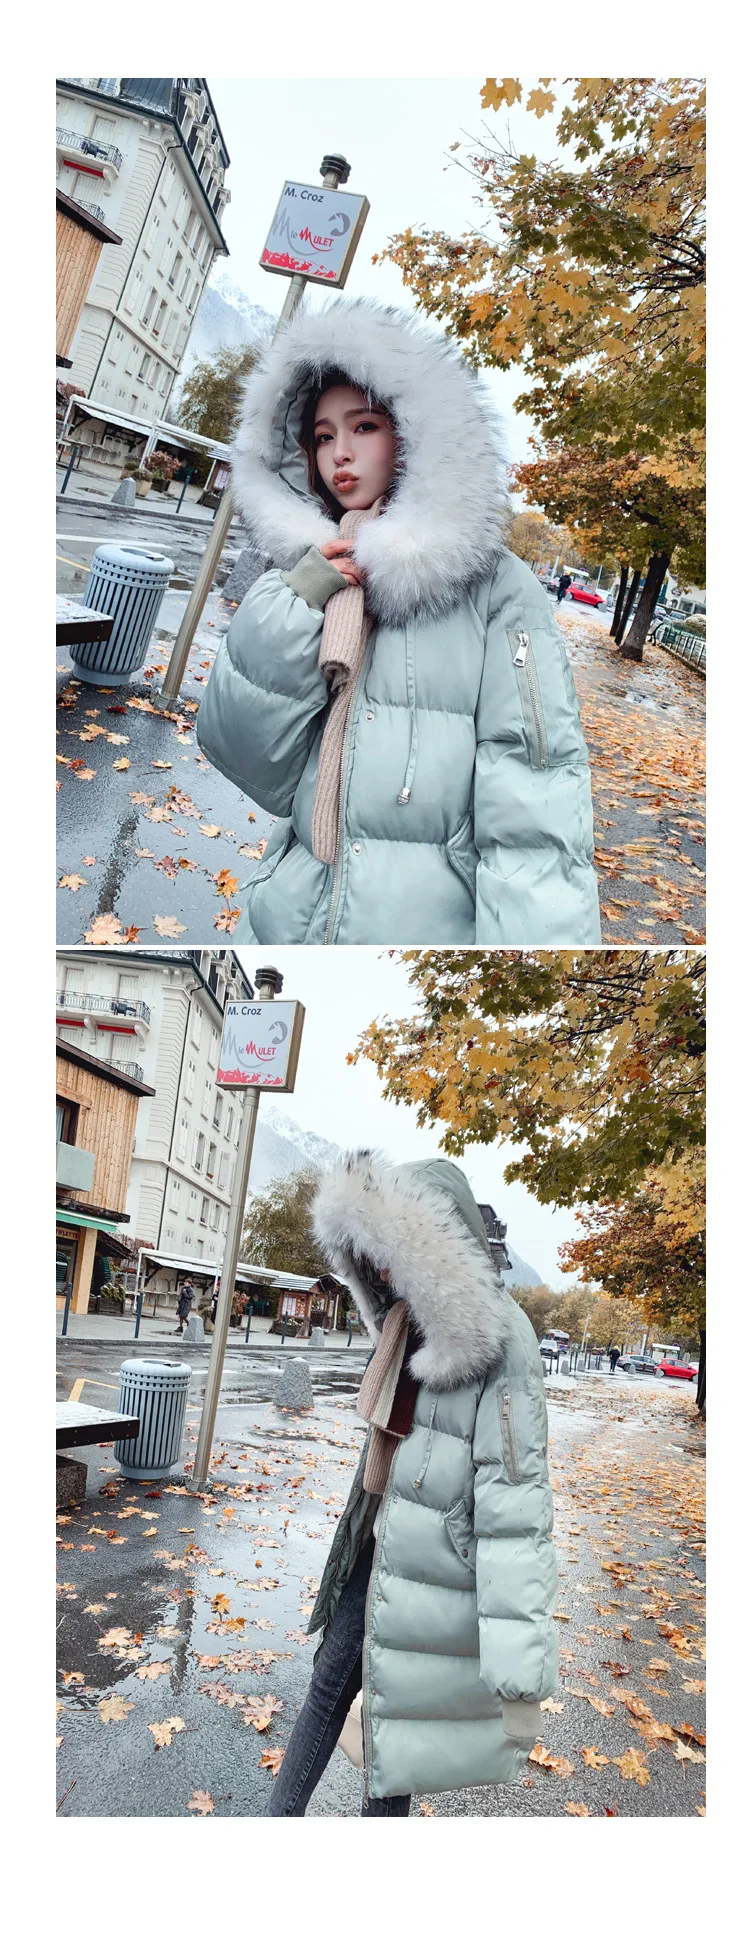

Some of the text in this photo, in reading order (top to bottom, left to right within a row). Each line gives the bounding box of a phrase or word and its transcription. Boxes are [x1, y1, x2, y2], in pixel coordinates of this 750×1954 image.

[284, 187, 324, 203] M. Croz
[290, 230, 298, 239] le
[299, 227, 334, 252] MULET
[227, 1006, 262, 1016] M. Croz
[238, 1046, 245, 1054] le
[245, 1040, 276, 1061] MULET
